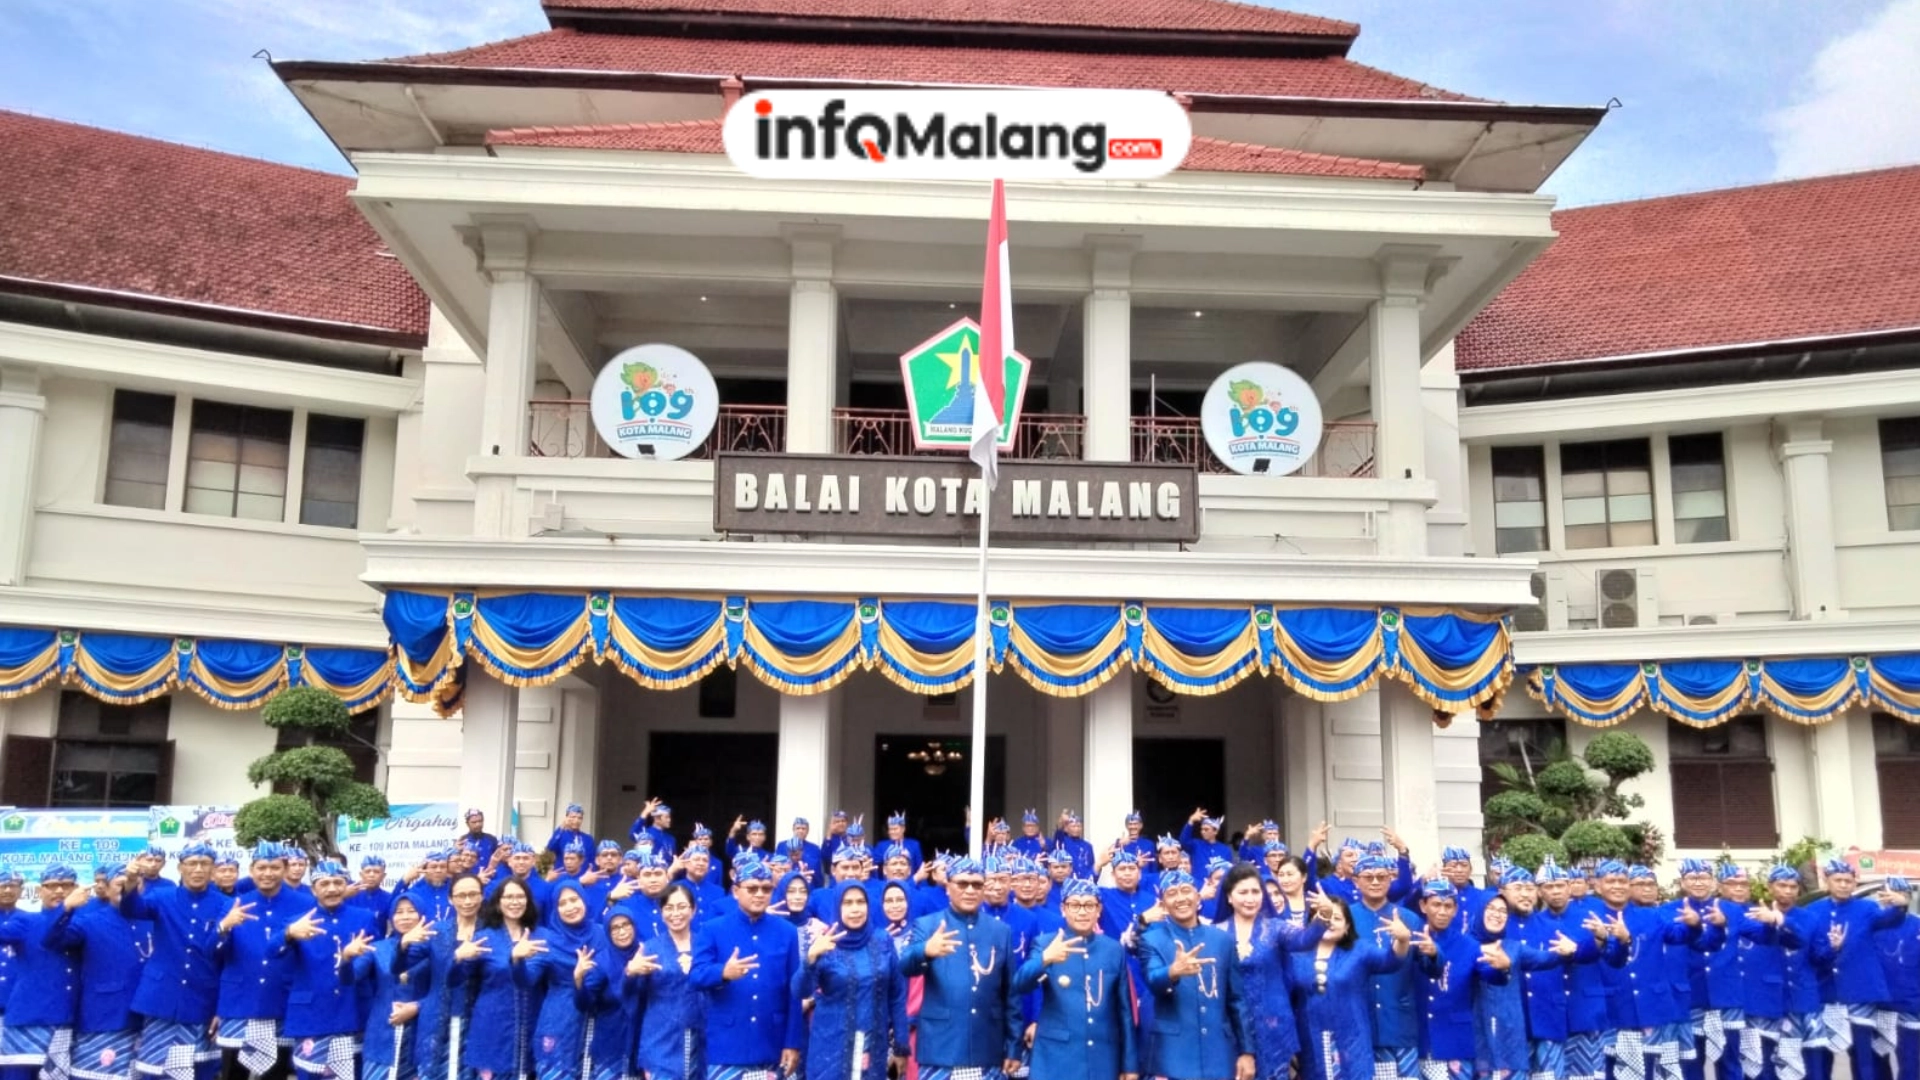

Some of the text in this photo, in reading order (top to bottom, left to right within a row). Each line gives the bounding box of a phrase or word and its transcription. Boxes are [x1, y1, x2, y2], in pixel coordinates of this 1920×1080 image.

[621, 389, 694, 420] 109
[1230, 407, 1299, 437] 109
[620, 424, 691, 437] KOTA MALANG
[1230, 441, 1299, 453] KOTA MALANG
[735, 472, 1181, 519] BALAI KOTA MALANG
[59, 840, 79, 850] KE
[95, 840, 119, 850] 109
[215, 839, 233, 848] KE
[349, 843, 362, 852] KE
[386, 841, 410, 850] KOTA
[412, 839, 449, 849] MALANG
[2, 855, 35, 863] KOTA
[40, 854, 93, 862] MALANG
